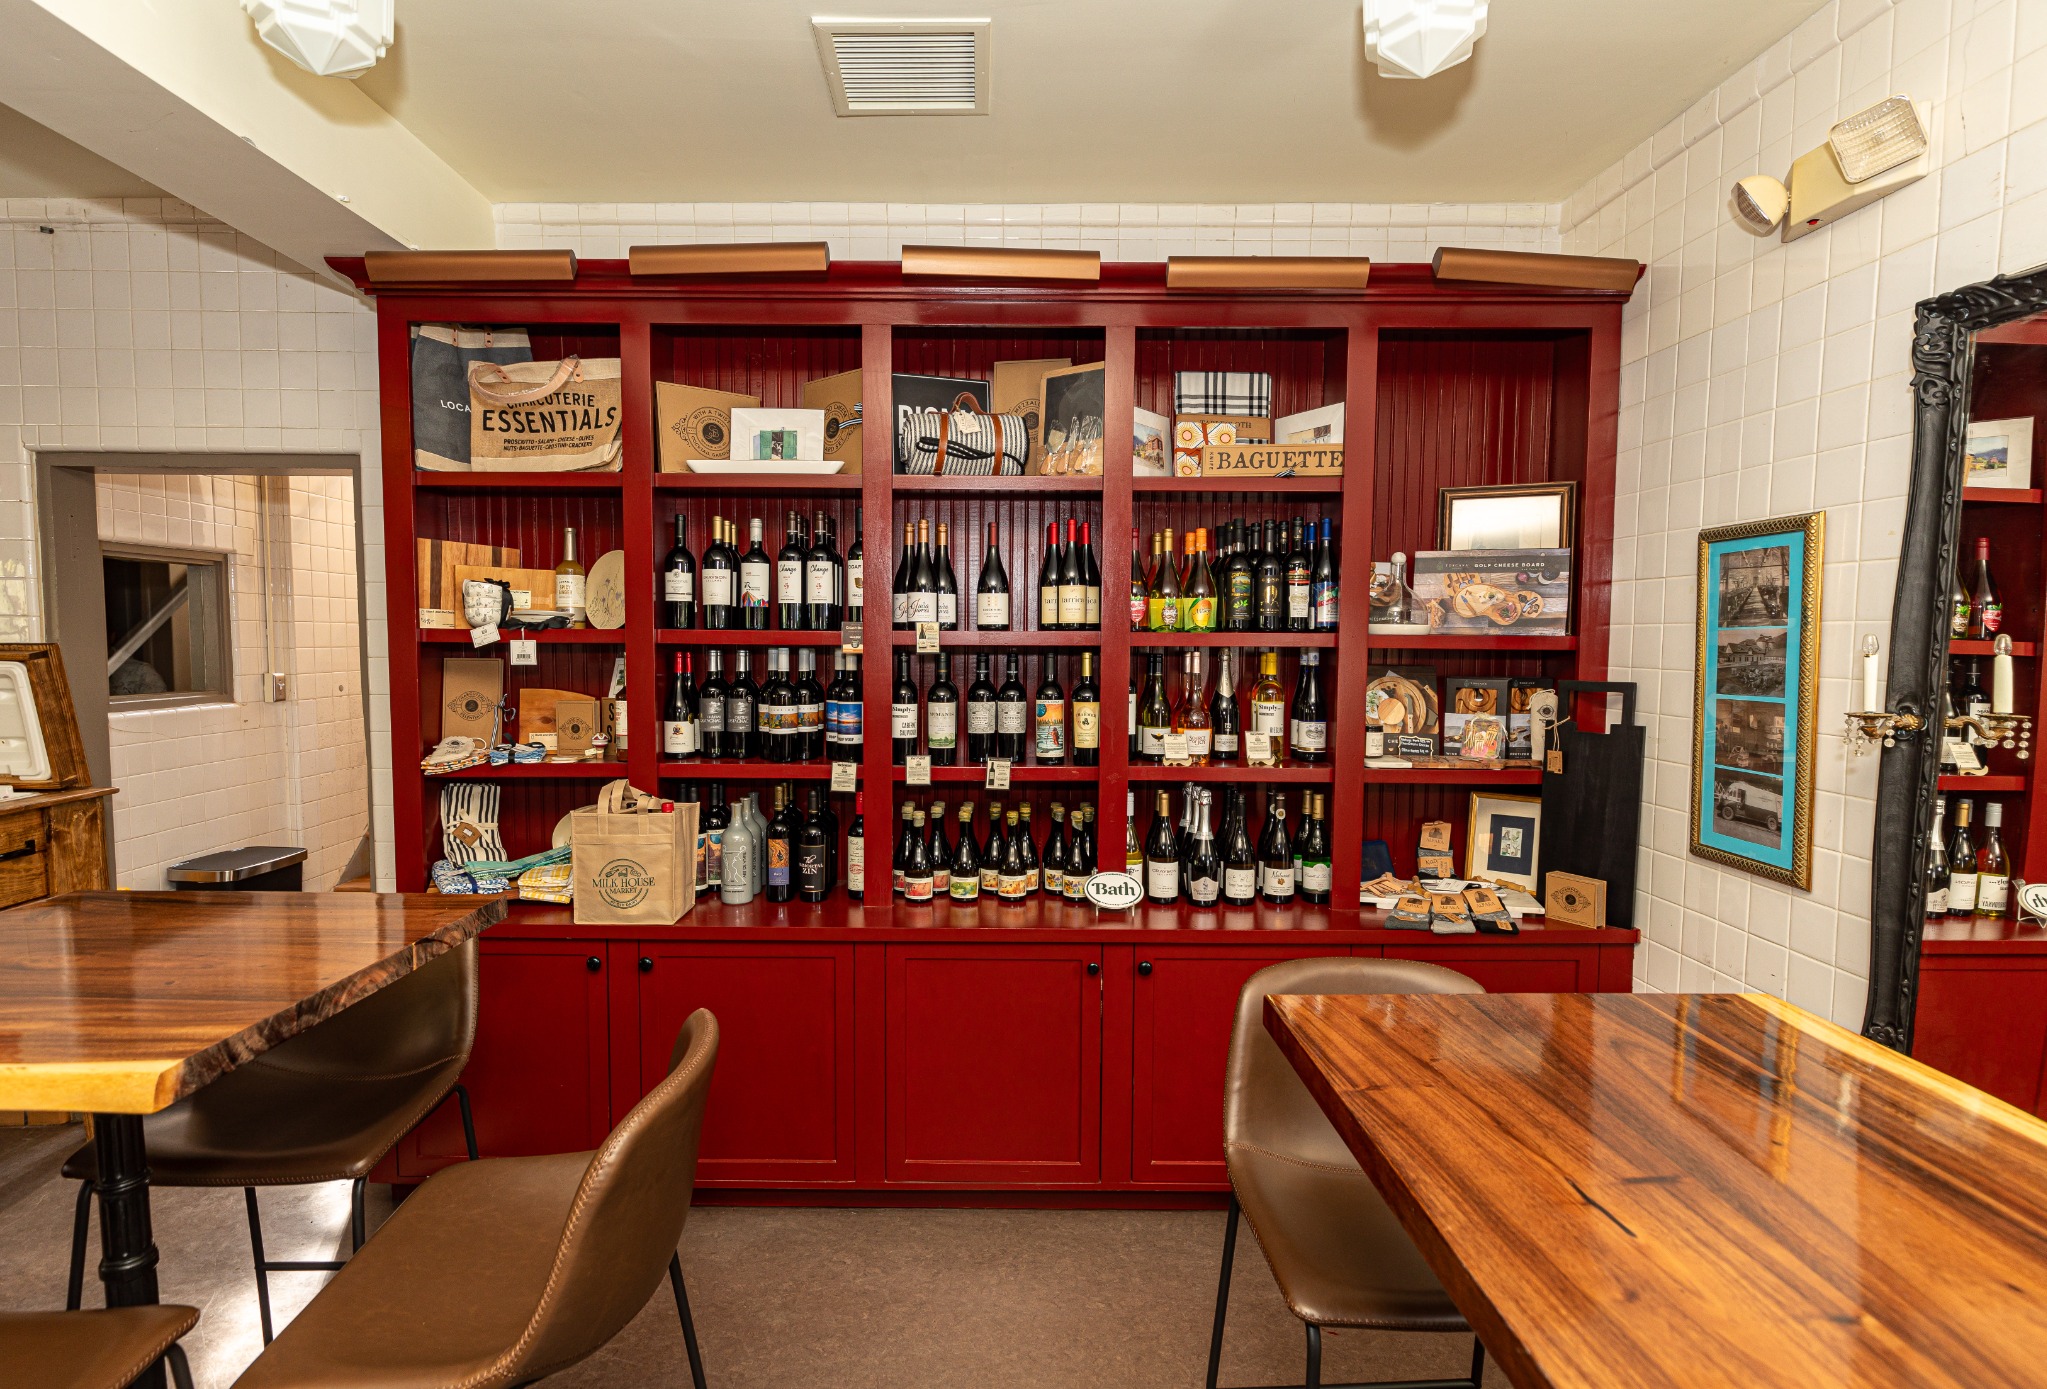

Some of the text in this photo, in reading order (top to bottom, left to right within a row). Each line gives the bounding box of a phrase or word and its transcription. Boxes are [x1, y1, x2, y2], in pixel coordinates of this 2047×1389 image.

[482, 406, 617, 433] ESSENTIALS
[693, 409, 706, 420] WITH
[1216, 450, 1342, 470] BAGUETTE
[810, 564, 829, 575] Change
[802, 867, 818, 875] ZIN
[592, 876, 656, 888] MILK HOUSE
[610, 886, 637, 894] MARKET
[1091, 881, 1136, 896] Bath
[1404, 902, 1424, 910] ALPAKA
